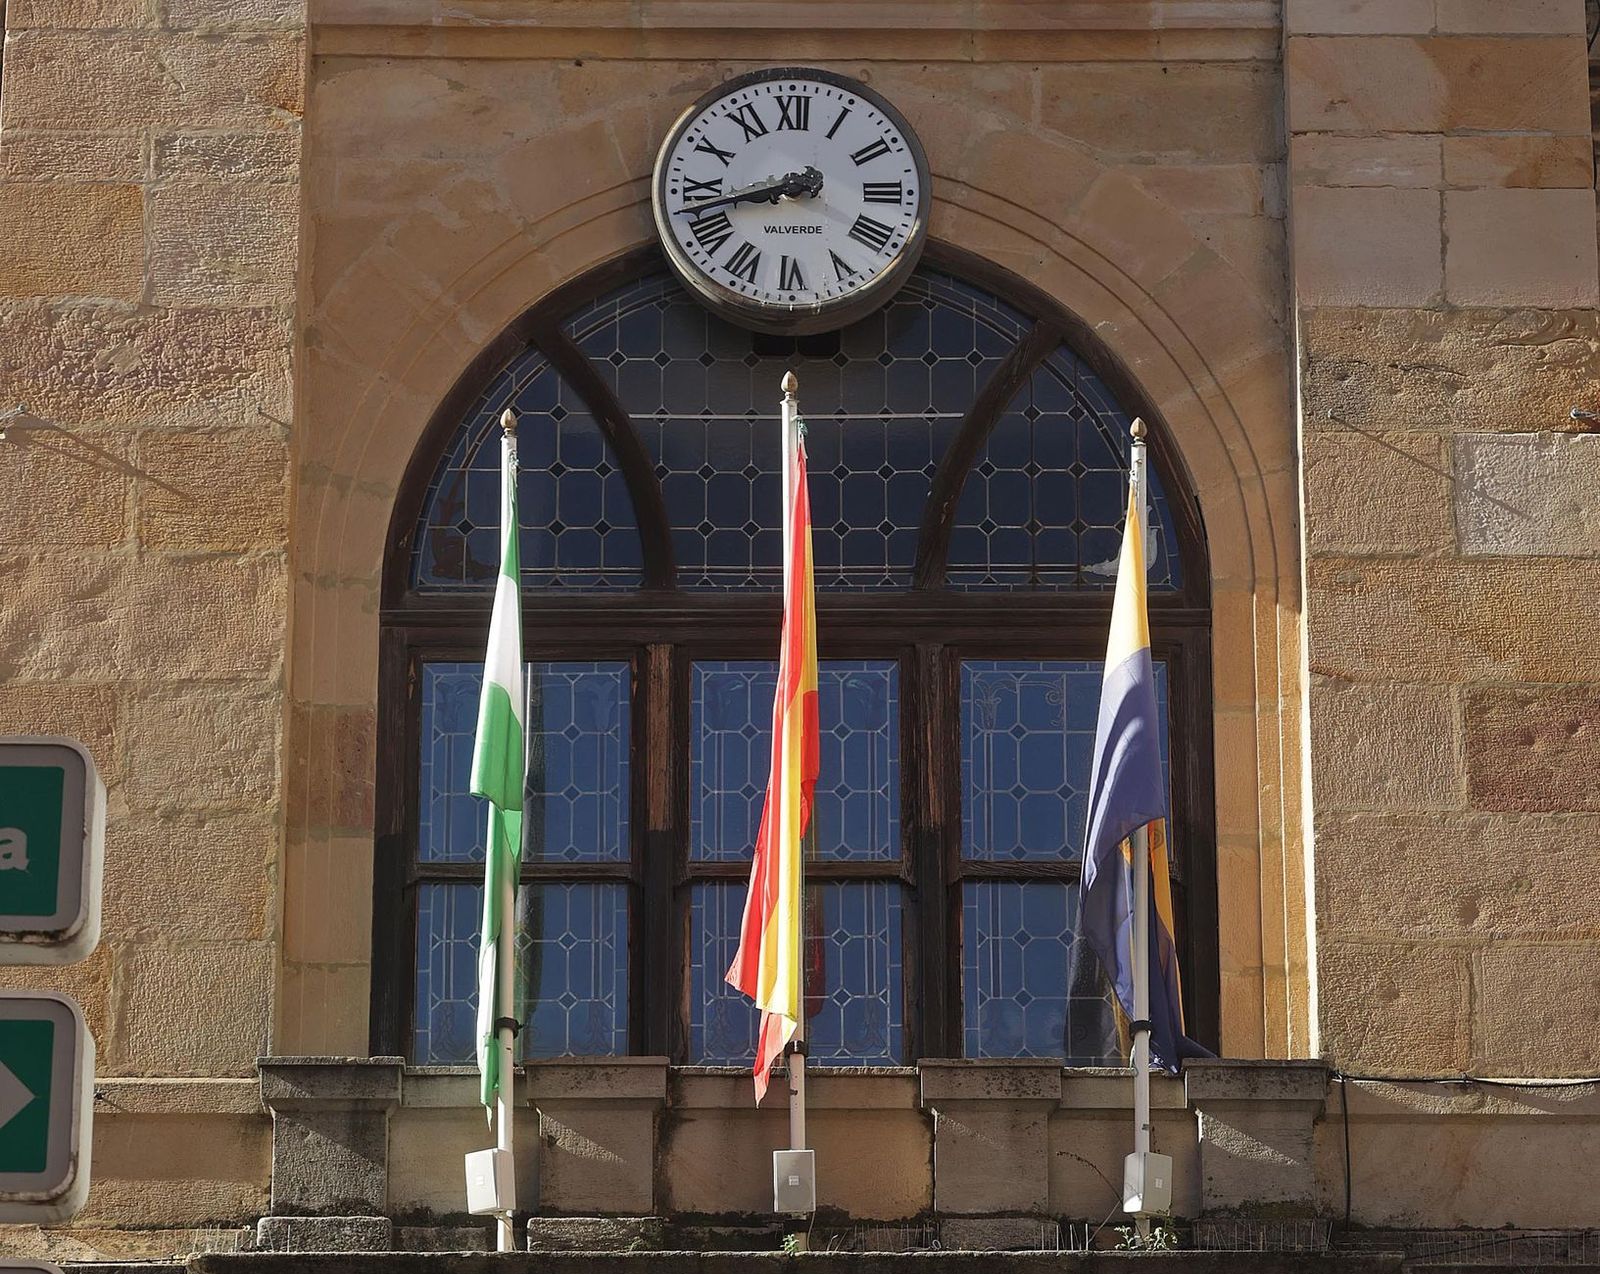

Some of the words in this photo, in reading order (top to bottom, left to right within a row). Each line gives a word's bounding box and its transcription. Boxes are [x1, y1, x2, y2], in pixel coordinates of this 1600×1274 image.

[724, 102, 769, 143] XI
[774, 96, 812, 131] XII
[825, 107, 852, 139] I
[693, 135, 736, 167] X
[850, 136, 893, 166] II
[683, 174, 723, 204] IX
[863, 180, 902, 206] III
[688, 210, 735, 258] VIII
[763, 224, 823, 235] VALVERDE
[847, 213, 895, 255] IIII
[721, 241, 761, 285] VII
[778, 255, 808, 291] VI
[829, 249, 858, 282] V
